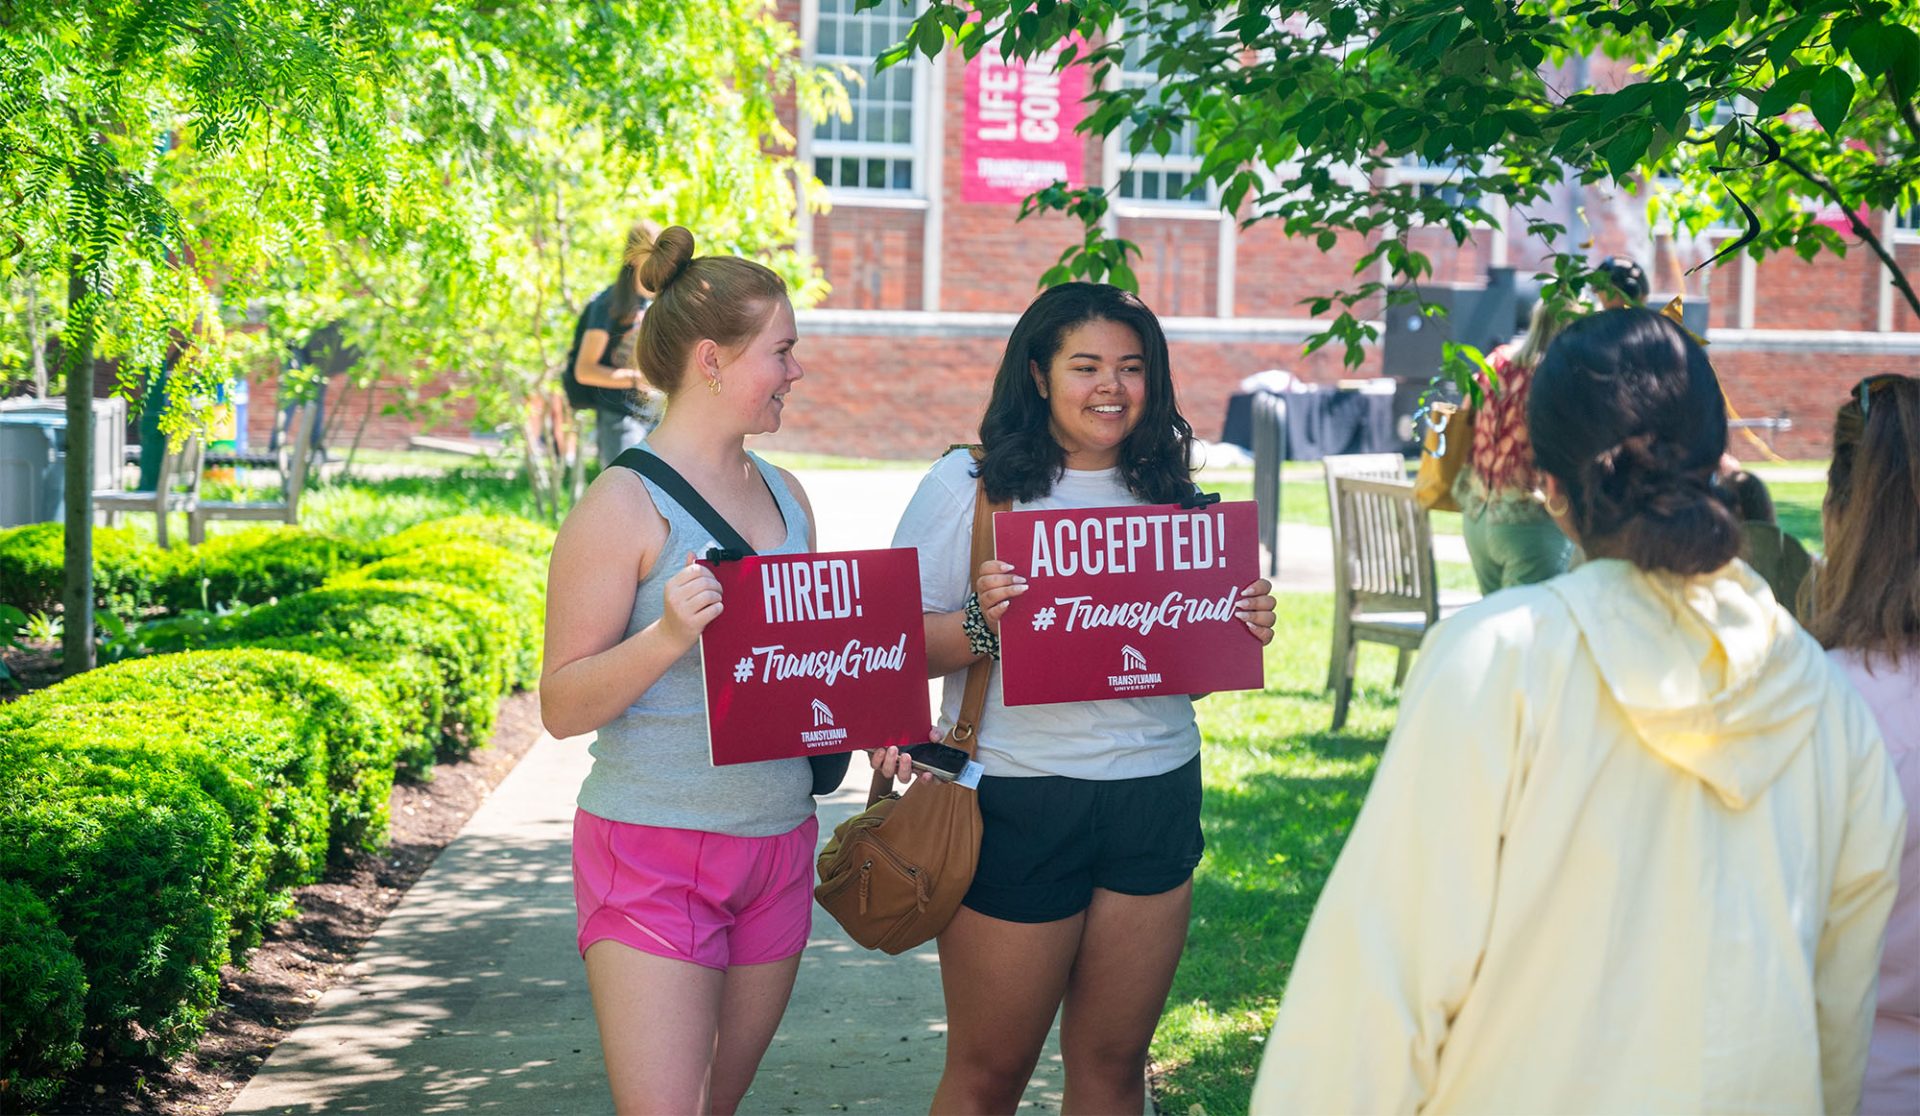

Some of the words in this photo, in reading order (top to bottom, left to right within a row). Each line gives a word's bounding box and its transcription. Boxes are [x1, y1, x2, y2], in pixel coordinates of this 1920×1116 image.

[978, 8, 1018, 141] LIFET
[1030, 513, 1226, 578] ACCEPTED!
[761, 559, 863, 624] HIRED!
[1031, 585, 1239, 636] #TransyGrad
[733, 633, 907, 687] #TransyGrad
[1107, 673, 1162, 686] TRANSYLVANIA
[1114, 684, 1156, 692] UNIVERSITY
[801, 728, 848, 743] TRANSYLVANIA
[806, 740, 842, 748] UNIVERSITY
